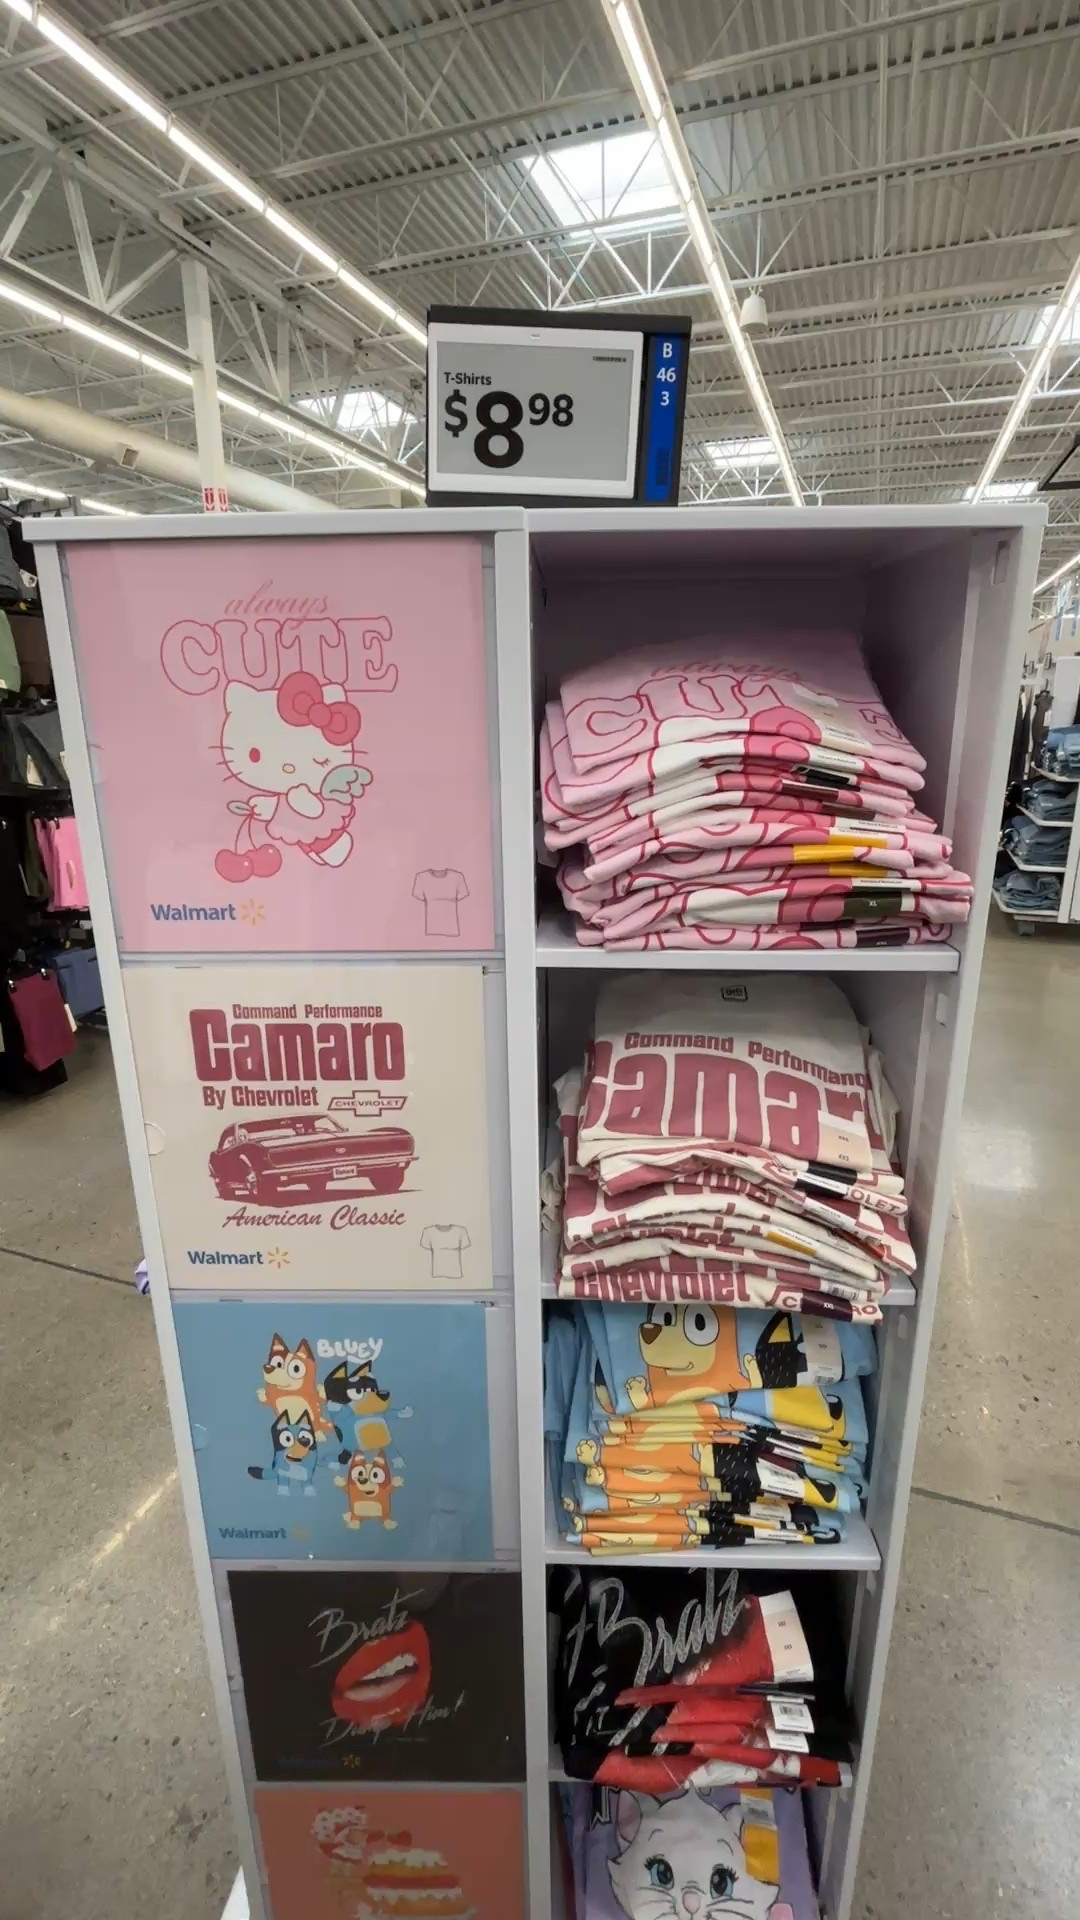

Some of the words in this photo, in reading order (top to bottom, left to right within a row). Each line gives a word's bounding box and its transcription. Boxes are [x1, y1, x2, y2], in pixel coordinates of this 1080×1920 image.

[662, 342, 673, 358] B
[443, 371, 492, 386] T-Shirts
[656, 367, 677, 382] 46
[659, 391, 670, 406] 3
[224, 579, 330, 629] always
[161, 615, 399, 696] CUTE
[150, 903, 236, 922] Walmart
[232, 1003, 297, 1020] Command
[304, 1003, 383, 1020] Performance
[189, 1008, 406, 1082] Camaro
[623, 1032, 735, 1054] Command
[202, 1085, 226, 1110] By
[231, 1085, 319, 1107] Chevrolet
[335, 1099, 400, 1107] CHEVROLET
[222, 1205, 324, 1229] American
[329, 1203, 407, 1231] Classic
[187, 1250, 264, 1266] Walmart
[316, 1337, 384, 1361] BLUEY
[218, 1526, 287, 1540] Walmart
[308, 1587, 426, 1669] Bratz
